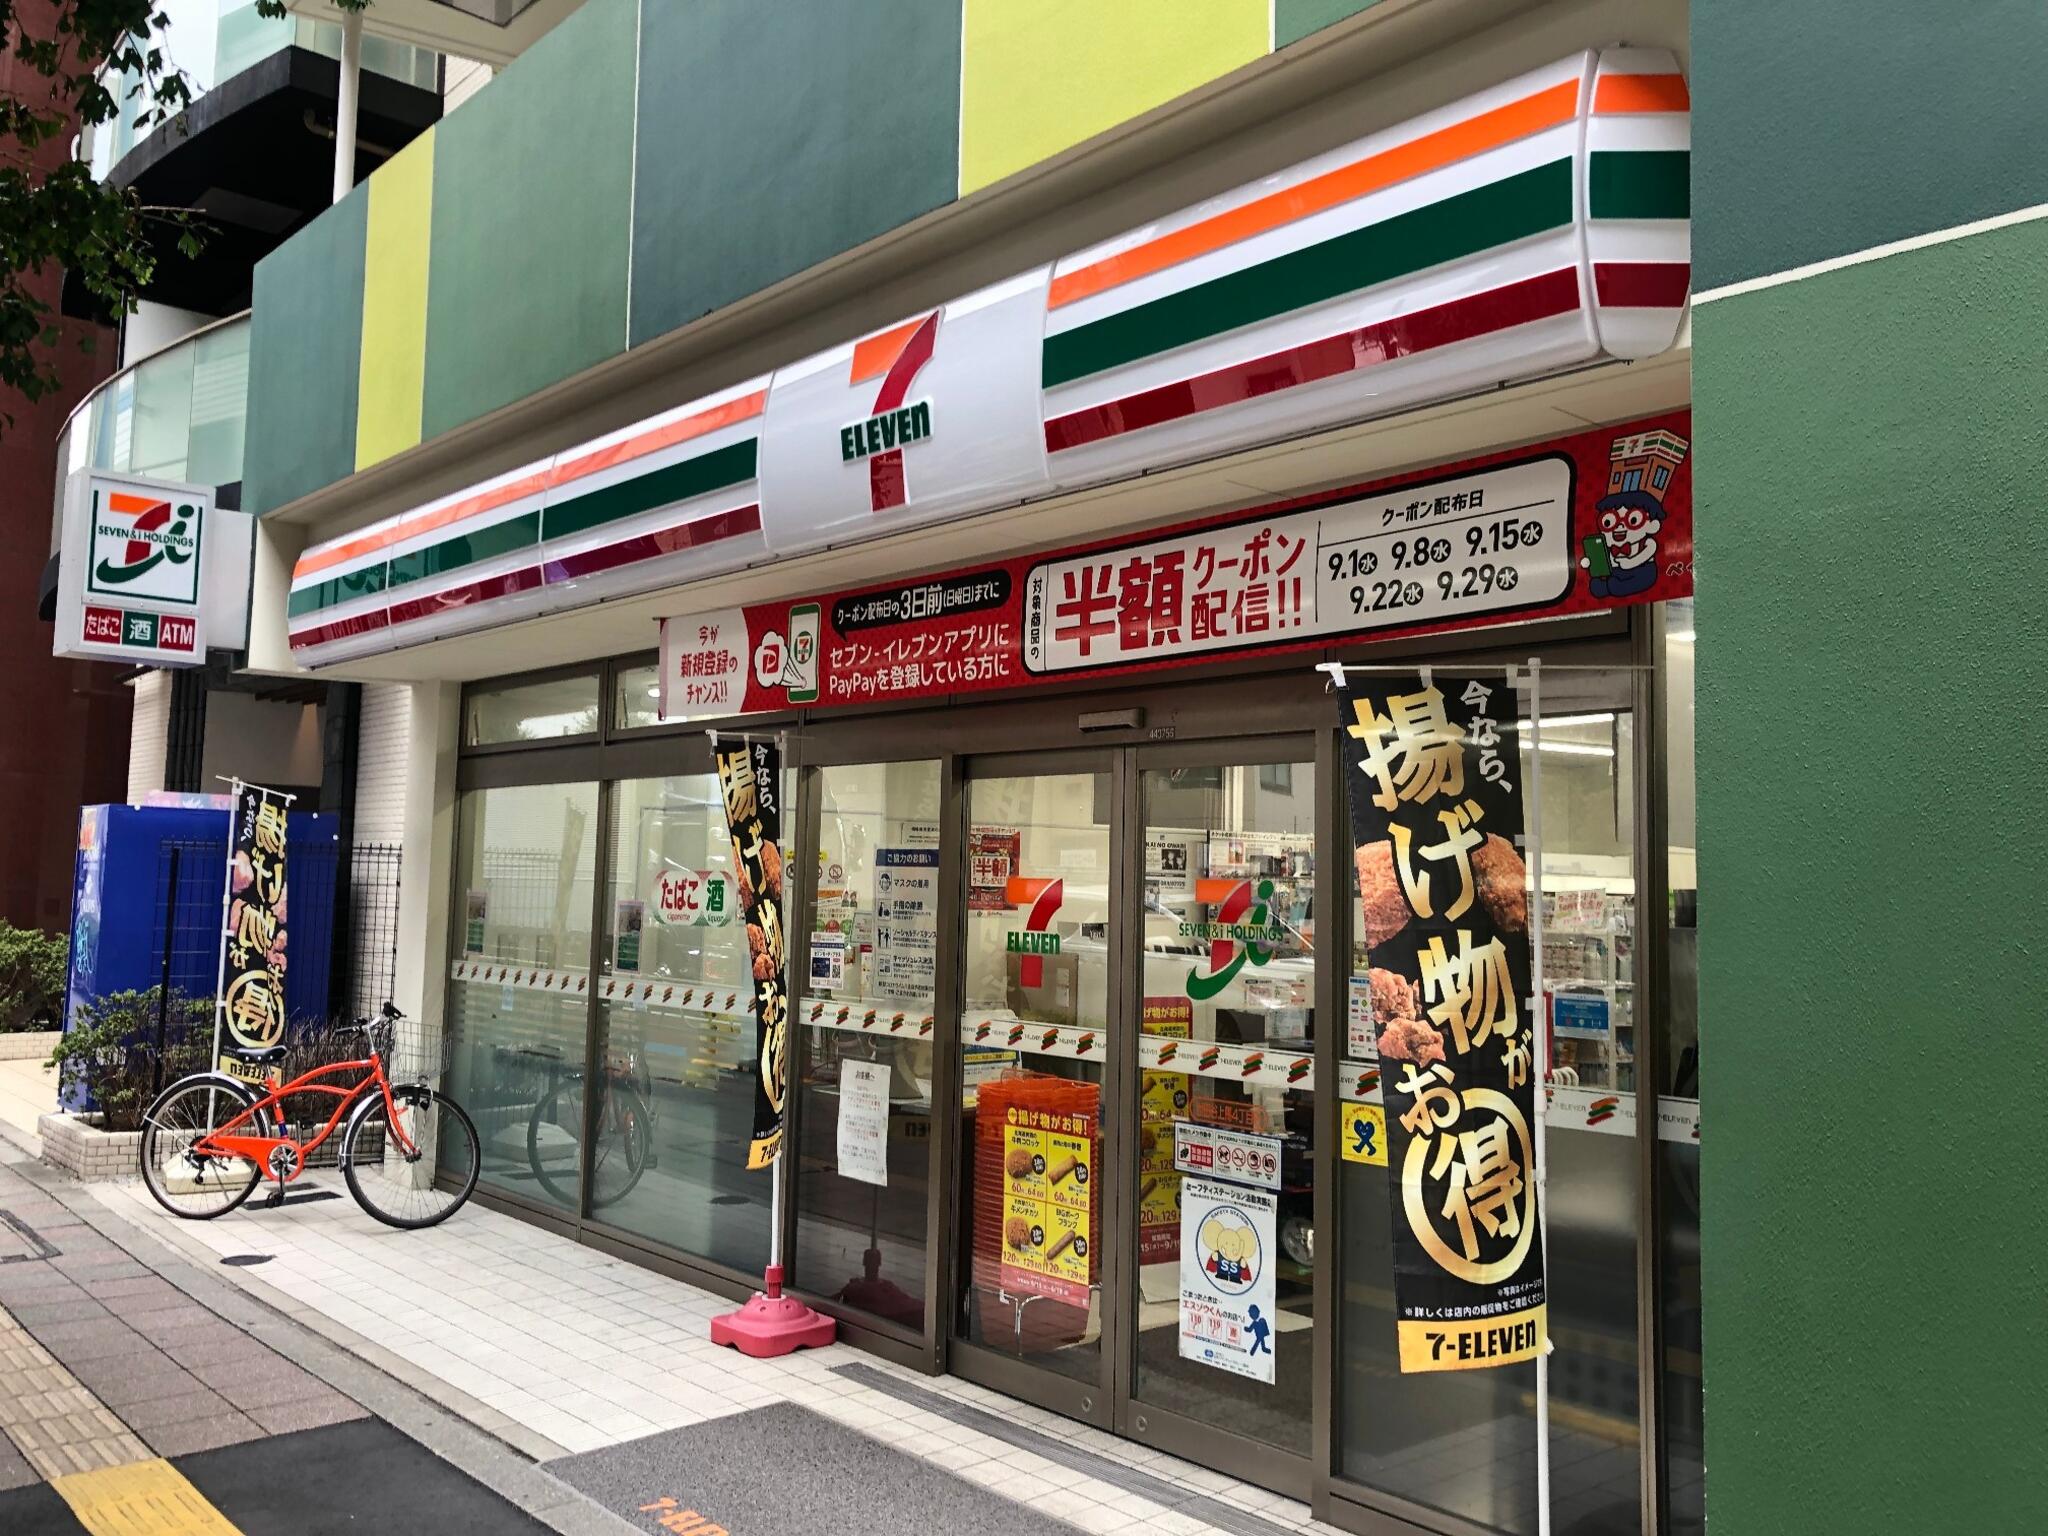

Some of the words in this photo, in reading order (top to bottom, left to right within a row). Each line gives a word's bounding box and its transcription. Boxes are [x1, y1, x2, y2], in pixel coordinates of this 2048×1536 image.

[1382, 488, 1484, 526] クーポン配布日
[143, 530, 194, 547] HOLDINGS
[1193, 528, 1306, 589] クーポン
[1055, 550, 1185, 656] 半額
[86, 614, 120, 638] たばこ
[129, 617, 153, 641] 酒
[1030, 577, 1043, 660] 対象商品の
[161, 622, 194, 645] ATM
[699, 624, 720, 646] 今が
[681, 650, 738, 677] 新規登録の
[829, 654, 1009, 698] PayPayを登録している方に
[661, 877, 698, 911] たばこ
[706, 879, 725, 912] 酒
[1226, 925, 1283, 942] HOLDINGS
[1220, 1259, 1238, 1274] SS
